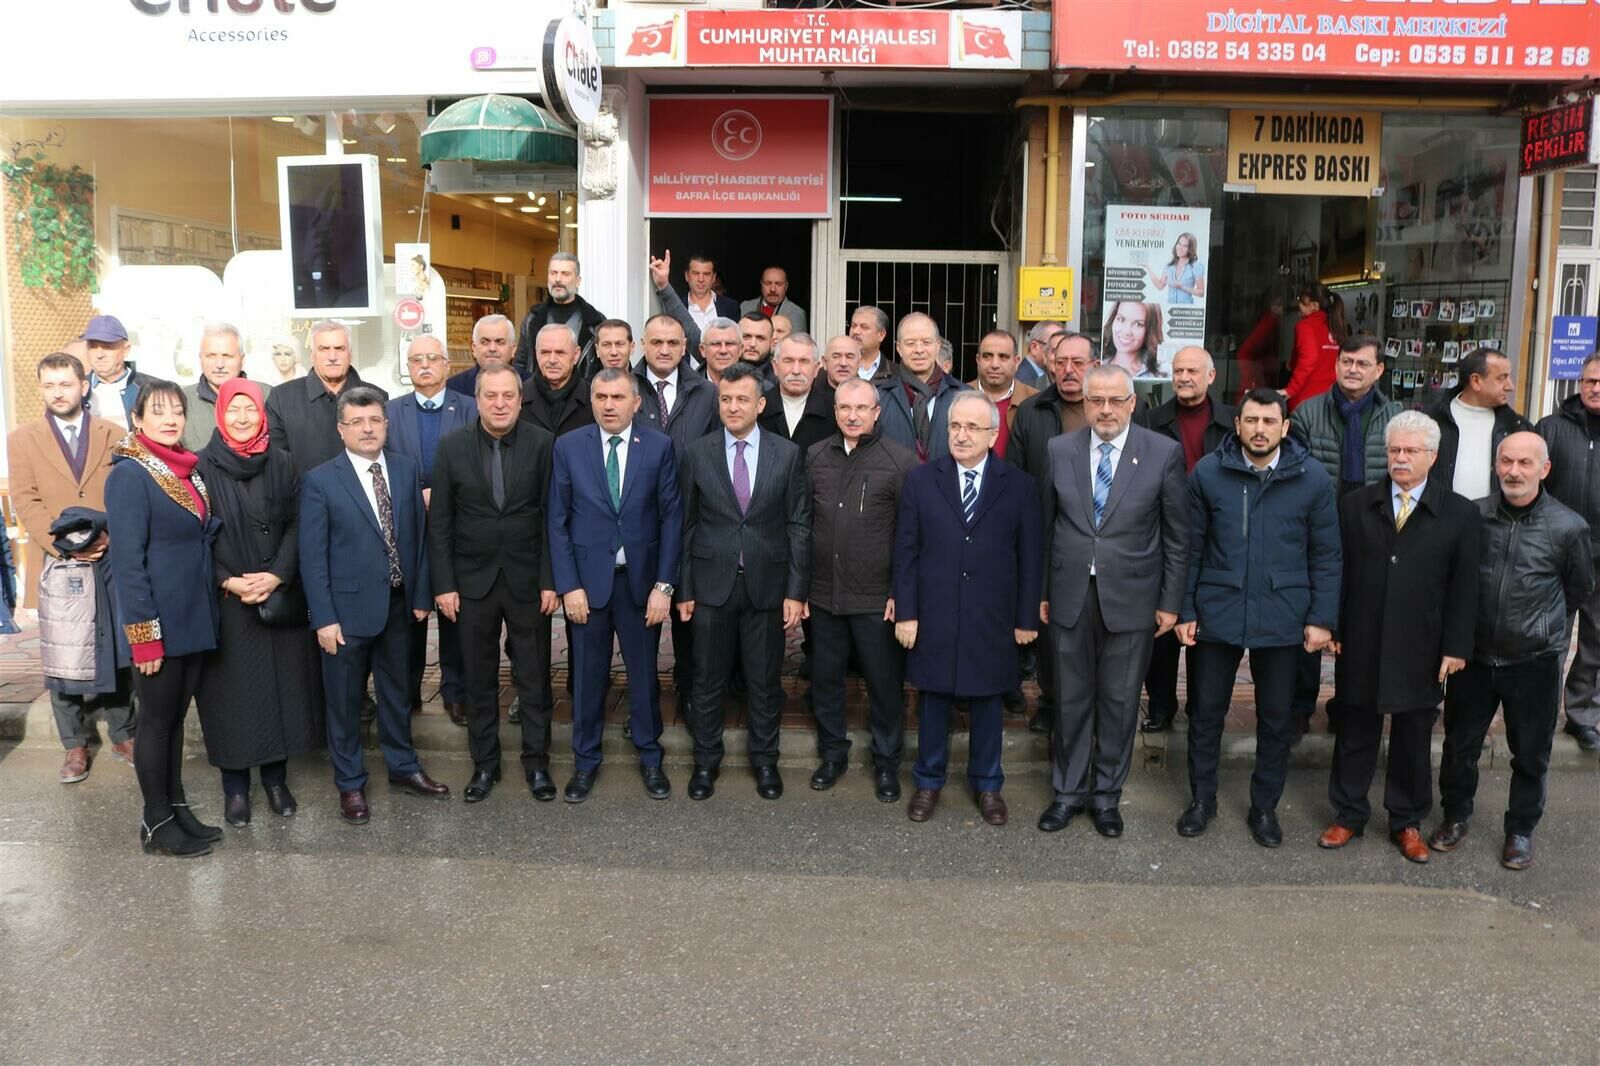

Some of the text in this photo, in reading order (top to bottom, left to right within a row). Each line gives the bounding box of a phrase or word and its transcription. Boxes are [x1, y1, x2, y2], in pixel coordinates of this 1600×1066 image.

[807, 14, 829, 26] T.C.
[1206, 8, 1507, 38] DİGİTAL BASKI MERKEZİ
[188, 27, 288, 42] Accessories
[699, 28, 936, 45] CUMHURİYET MAHALLESİ
[759, 44, 876, 64] MUHTARLIĞI
[1123, 40, 1590, 67] Tel: 0362 54 335 04 Cep: 0535 511 32 58
[1254, 111, 1364, 144] 7 DAKİKADA
[1238, 153, 1370, 182] EXPRES BASKI
[653, 172, 824, 186] MİLLİYETÇİ HAREKET PARTİSİ
[676, 190, 800, 203] BAFRA İLÇE BAŞKANLIĞI
[1120, 212, 1190, 222] FOTO SERDAR
